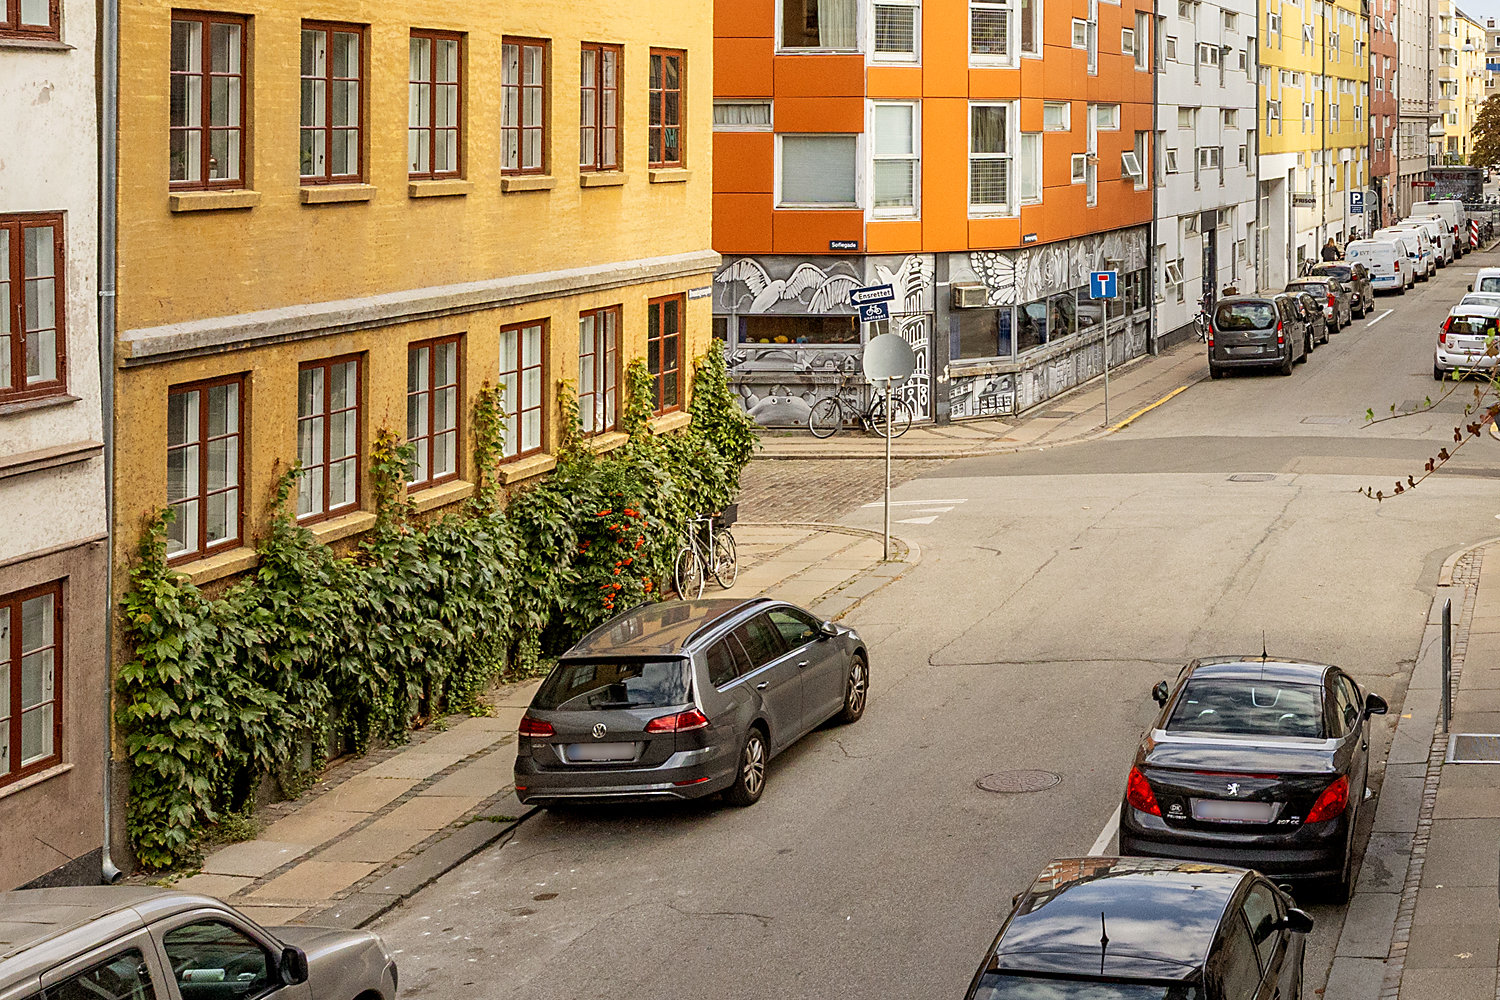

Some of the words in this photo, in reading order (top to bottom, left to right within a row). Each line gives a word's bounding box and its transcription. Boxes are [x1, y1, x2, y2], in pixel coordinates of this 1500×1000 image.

[1352, 192, 1361, 205] P
[831, 241, 857, 249] Sofiegade
[858, 289, 891, 300] Ensrettet
